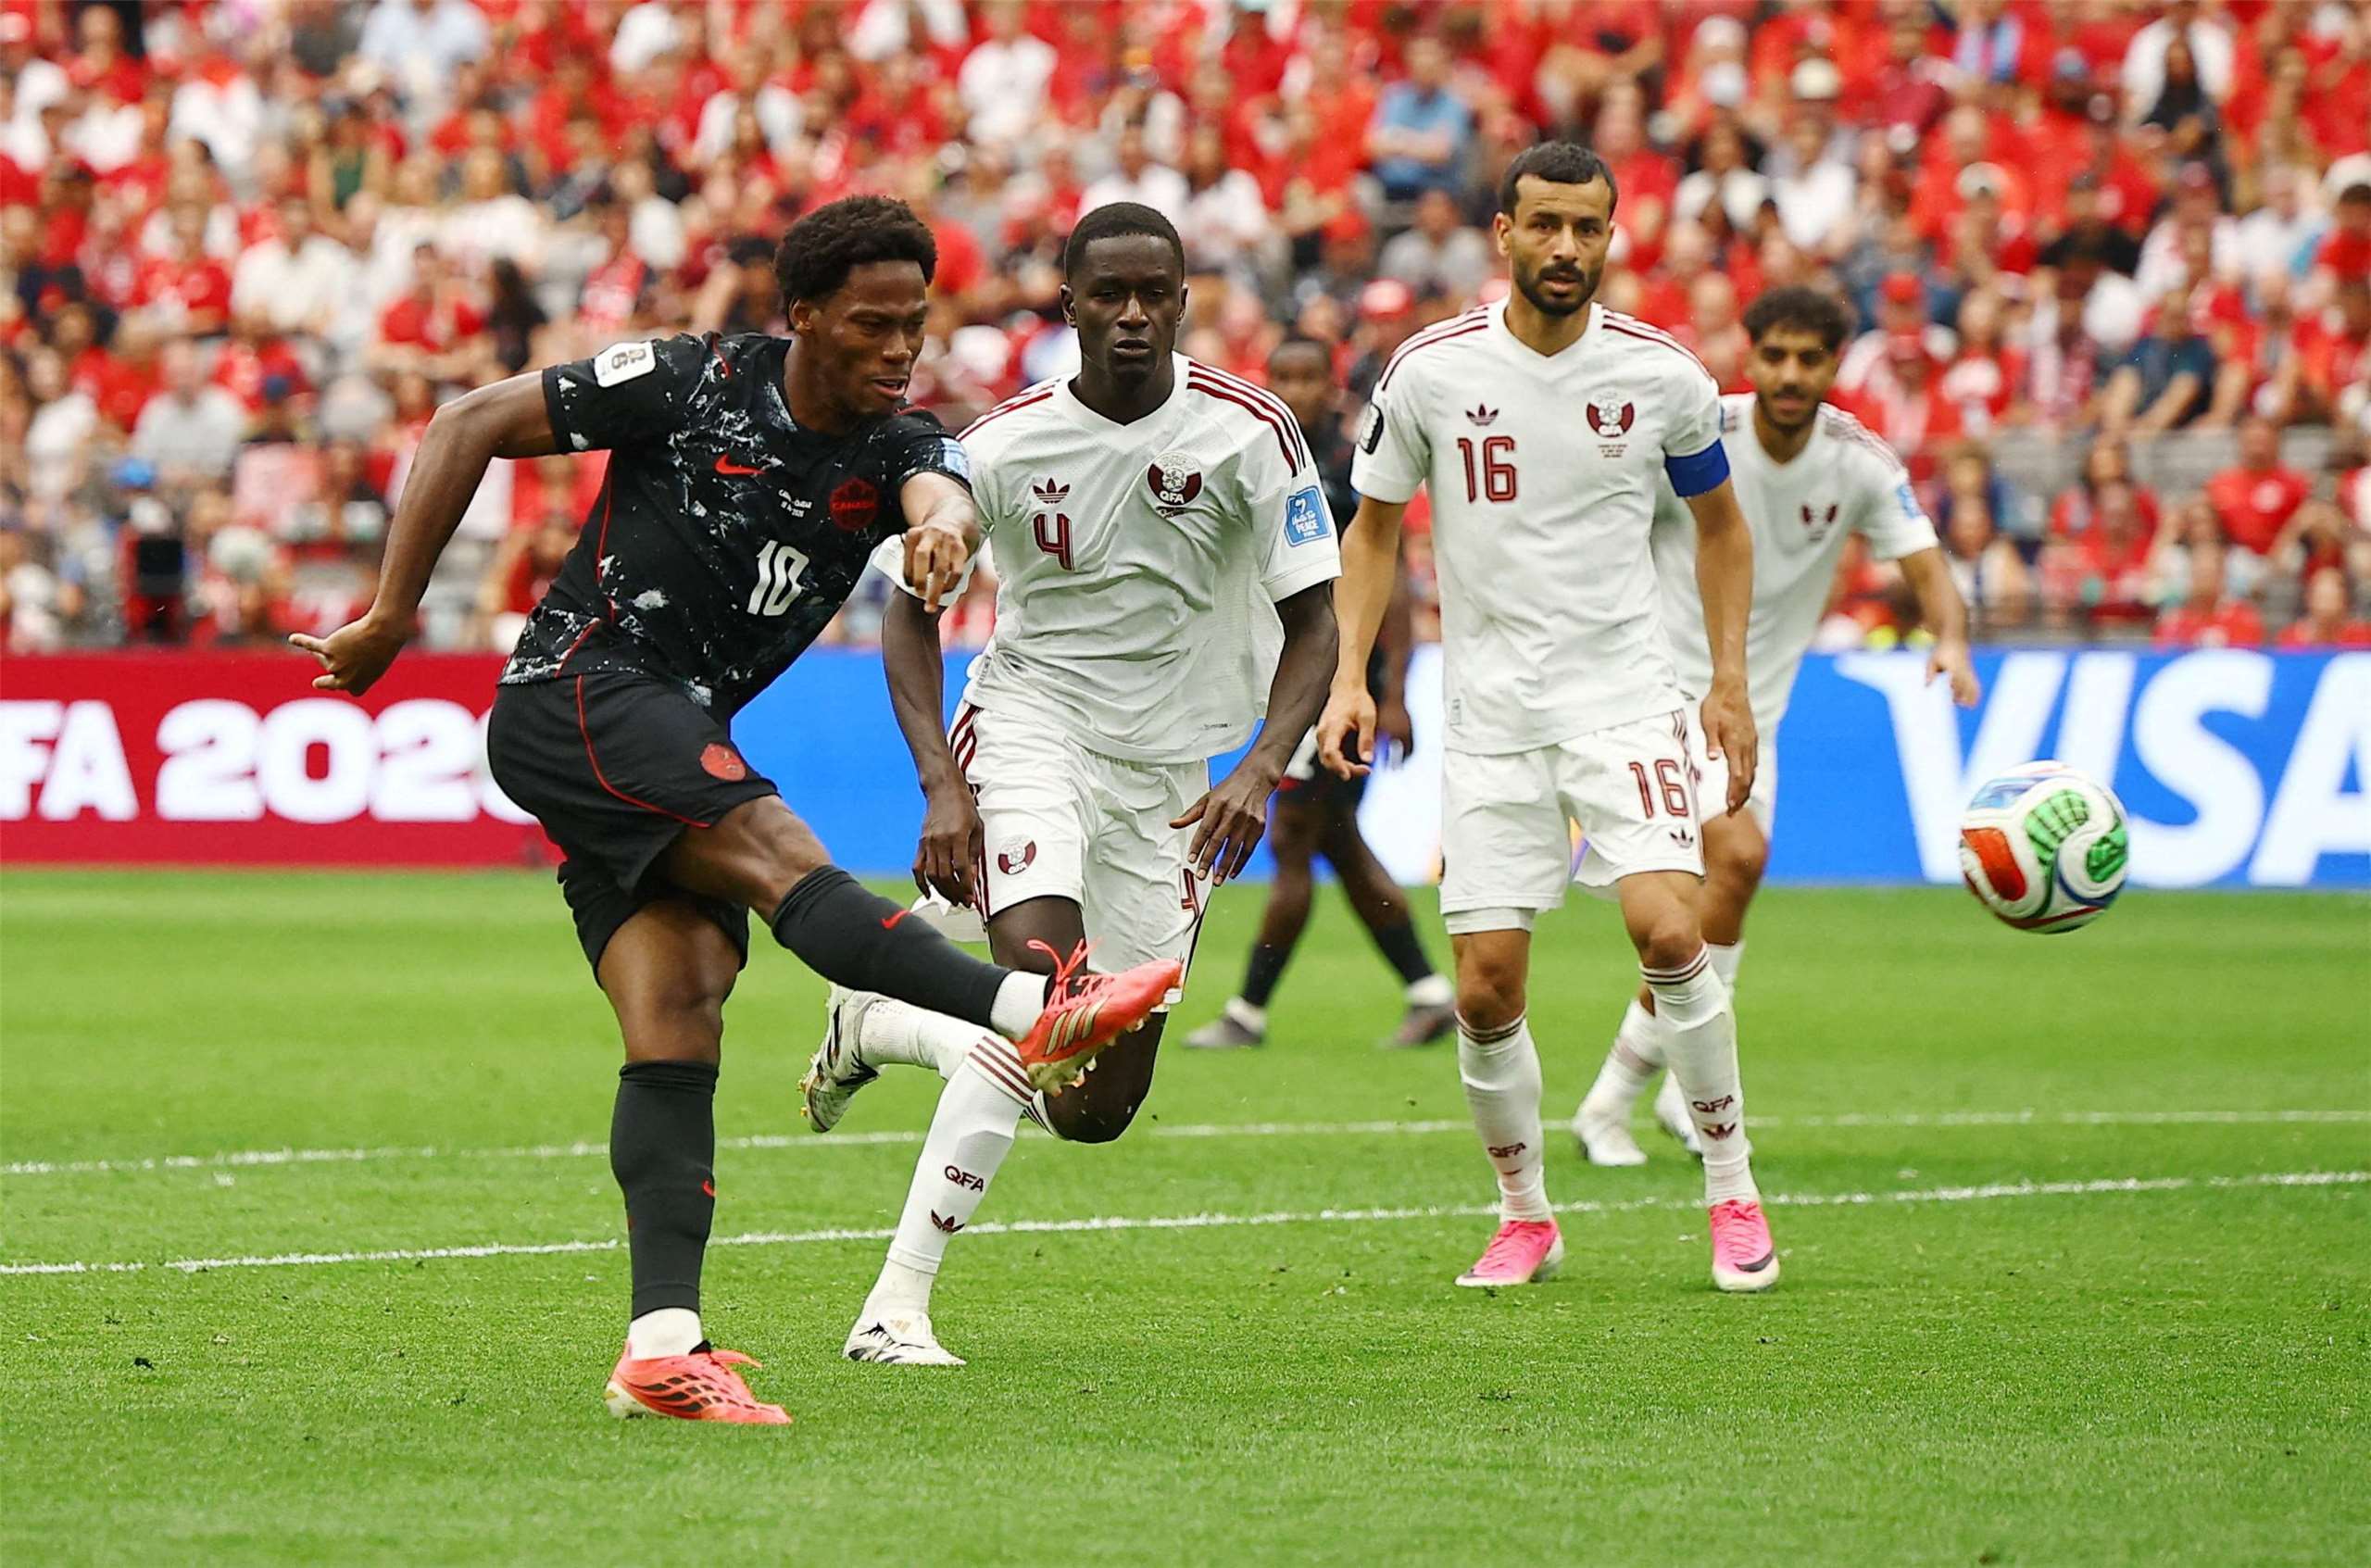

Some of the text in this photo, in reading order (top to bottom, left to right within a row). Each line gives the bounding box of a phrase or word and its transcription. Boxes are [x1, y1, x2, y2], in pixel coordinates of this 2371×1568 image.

[1160, 490, 1185, 504] QFA
[1457, 435, 1518, 505] 16
[1033, 513, 1075, 571] 4
[746, 539, 810, 617] 10
[1628, 759, 1688, 820] 16
[1832, 647, 2371, 889] VISA
[1691, 1089, 1734, 1112] QFA
[944, 1165, 985, 1193] QFA
